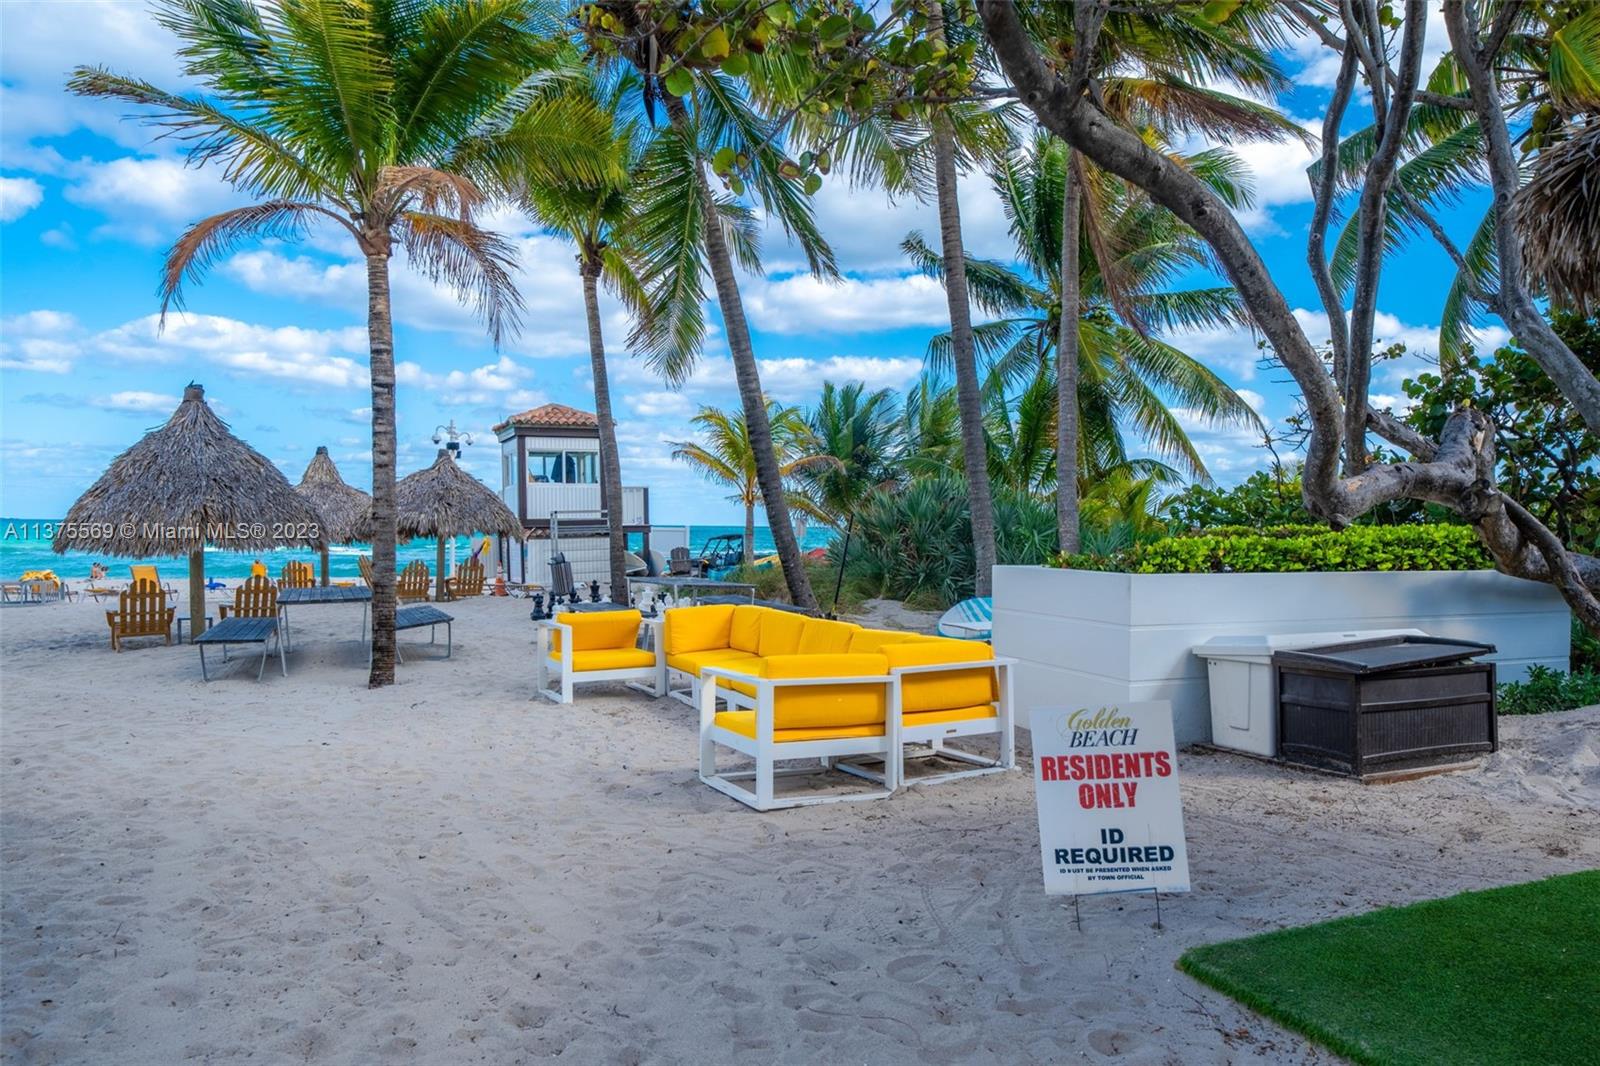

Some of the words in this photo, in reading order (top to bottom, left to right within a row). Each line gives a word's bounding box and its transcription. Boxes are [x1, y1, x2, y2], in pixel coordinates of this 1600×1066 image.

[1067, 707, 1132, 731] Golden
[1069, 728, 1139, 748] BEACH
[1041, 751, 1172, 781] RESIDENTS
[1078, 782, 1138, 810] ONLY
[1100, 828, 1124, 845] ID
[1054, 845, 1175, 865] REQUIRED
